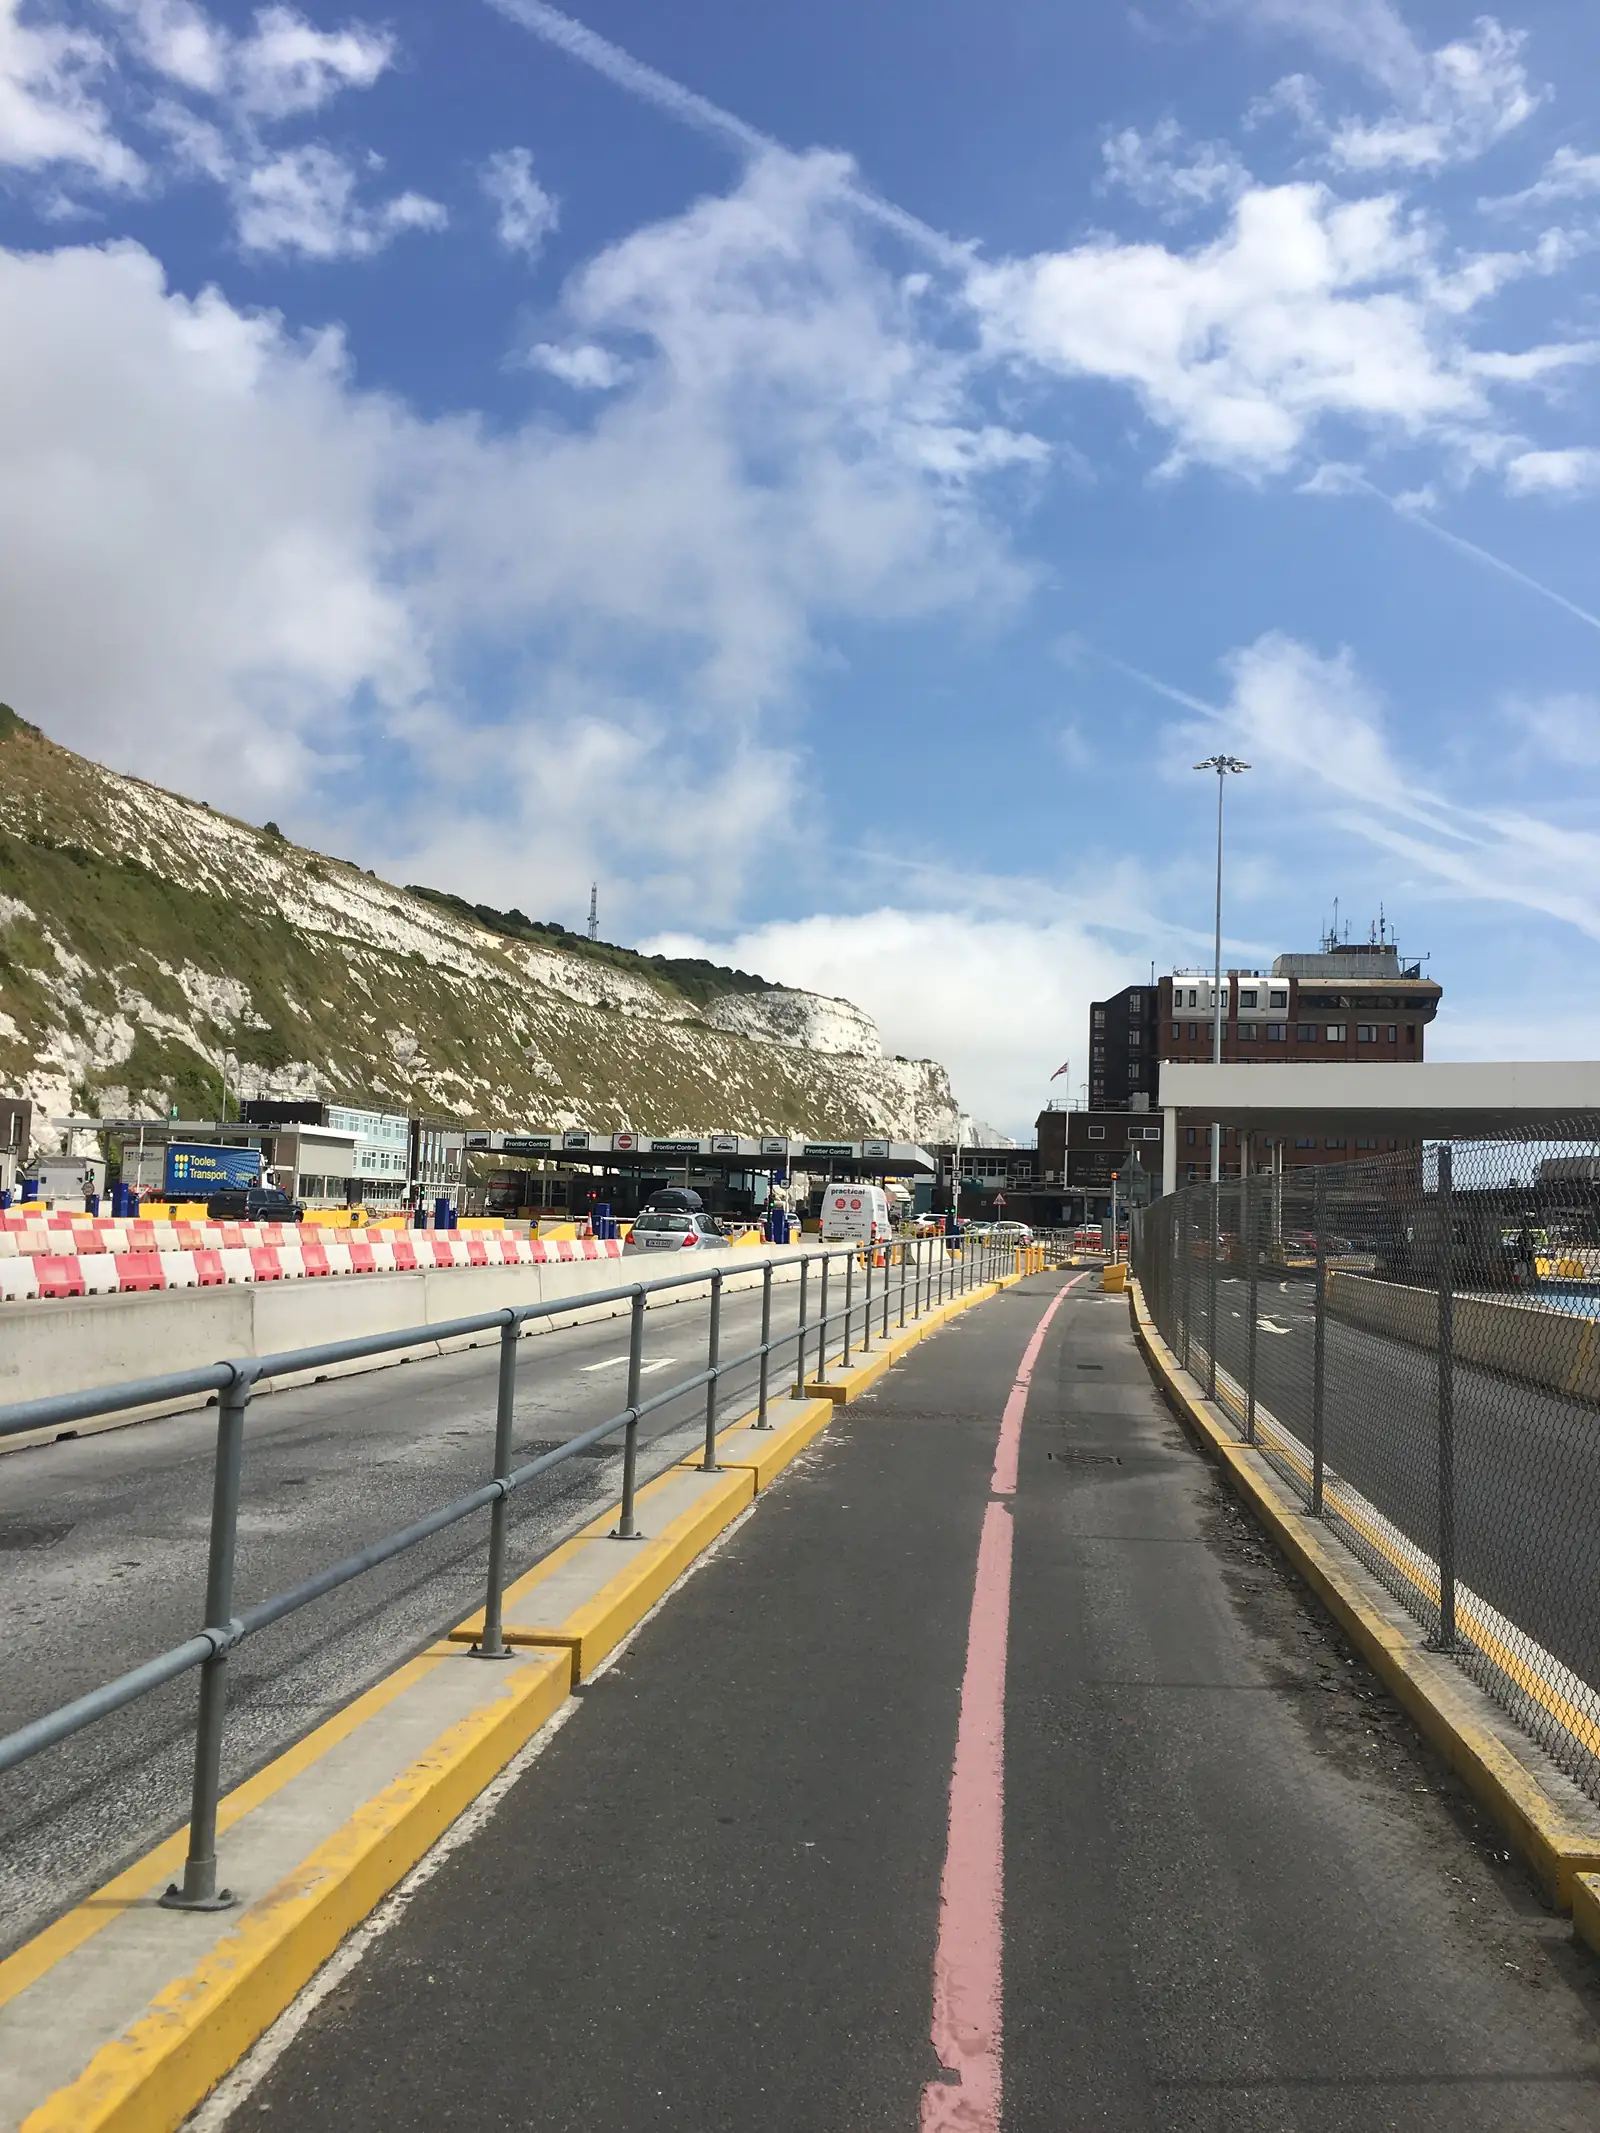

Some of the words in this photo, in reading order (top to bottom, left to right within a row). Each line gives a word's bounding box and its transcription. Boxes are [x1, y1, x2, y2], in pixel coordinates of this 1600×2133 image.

[805, 1147, 828, 1155] Frontier
[189, 1155, 216, 1167] Tooles
[189, 1168, 227, 1181] Transport
[830, 1188, 866, 1196] practical
